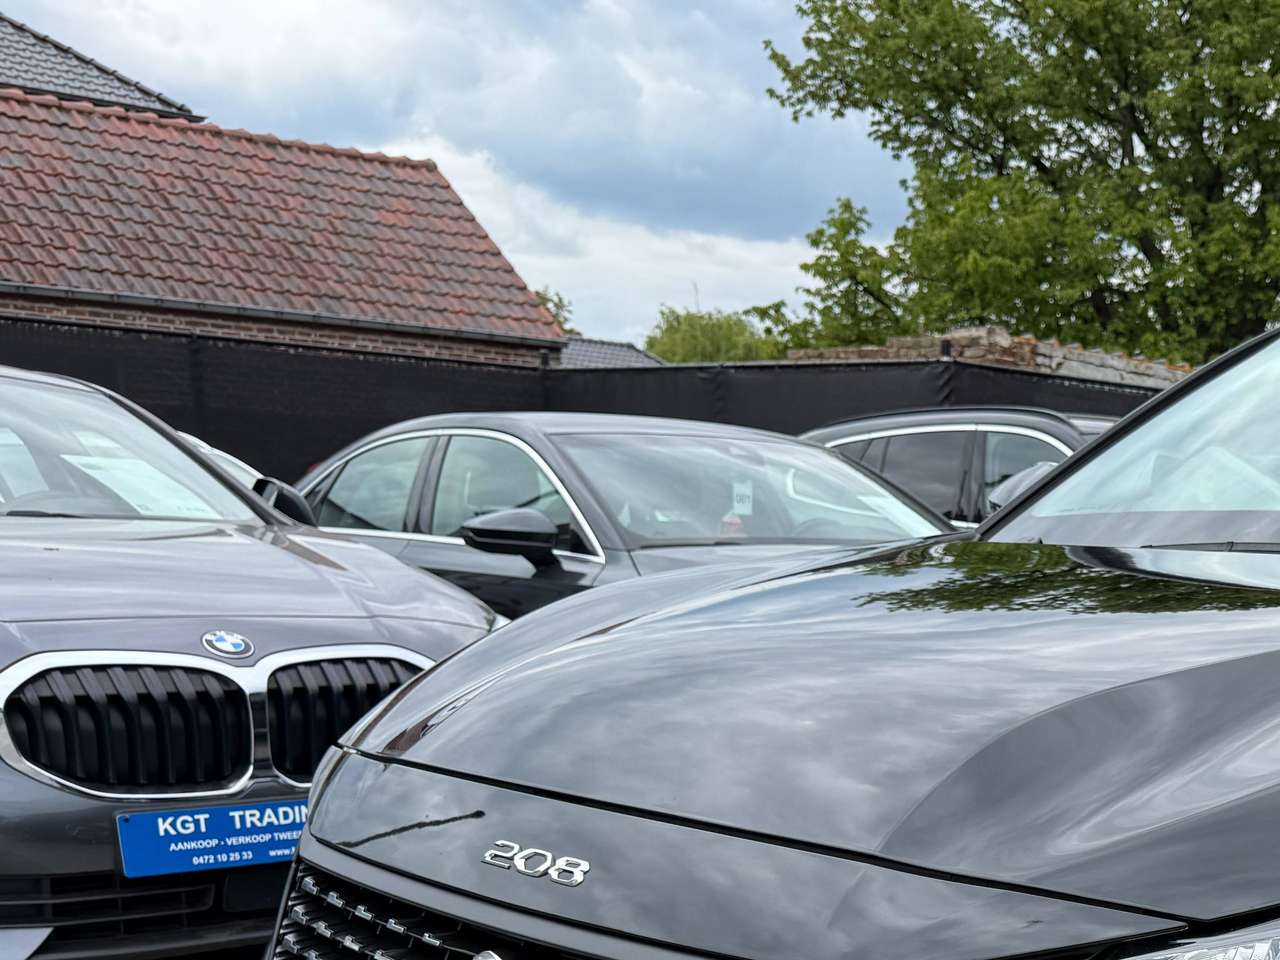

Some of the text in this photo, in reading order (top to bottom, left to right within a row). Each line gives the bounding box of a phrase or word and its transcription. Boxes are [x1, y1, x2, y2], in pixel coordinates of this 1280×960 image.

[157, 813, 210, 837] KGT
[169, 838, 219, 852] AANKOOP
[225, 833, 272, 846] VERKOOP
[192, 854, 215, 865] 0472
[217, 853, 228, 862] 10
[229, 852, 240, 861] 25
[241, 850, 253, 860] 33
[481, 840, 591, 887] 208
